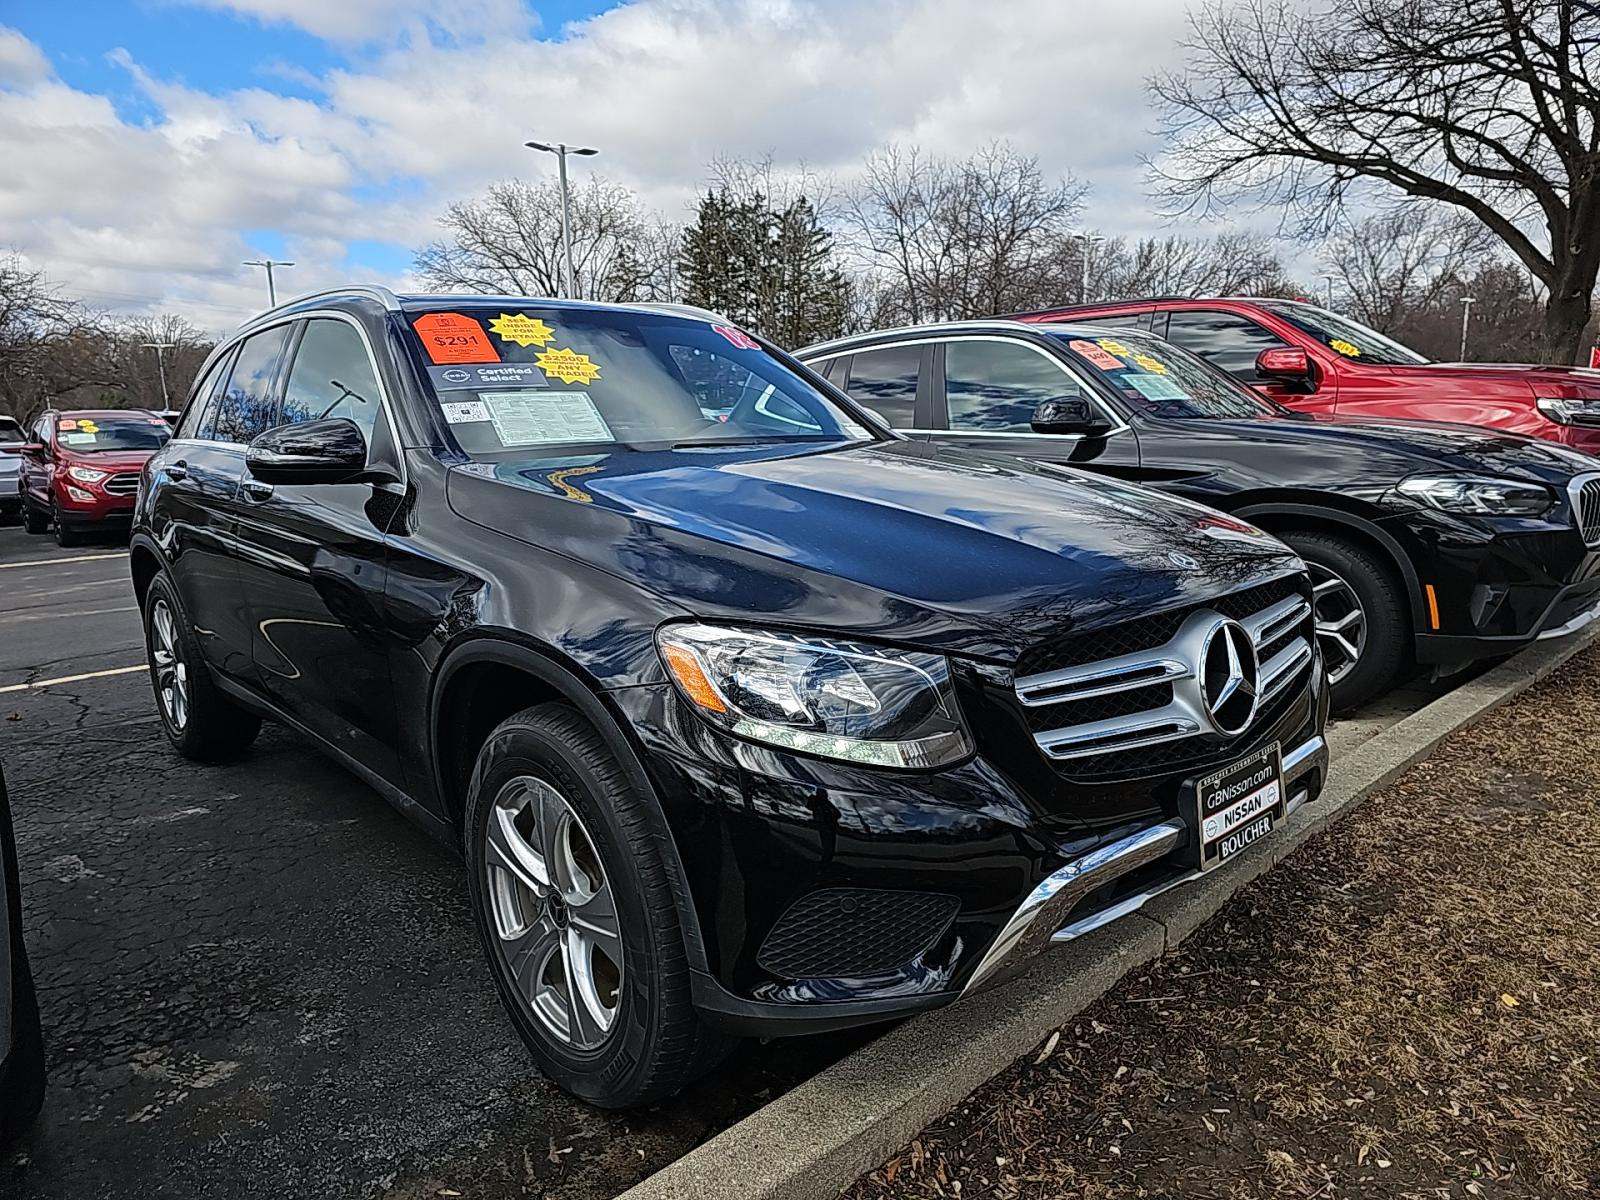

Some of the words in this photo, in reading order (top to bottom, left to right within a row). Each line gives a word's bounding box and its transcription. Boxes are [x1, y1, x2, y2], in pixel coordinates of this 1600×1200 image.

[433, 335, 479, 347] $291
[543, 354, 584, 362] $2500
[476, 367, 533, 376] Certified
[480, 374, 523, 382] Select
[1207, 766, 1272, 809] GBNissan.com
[1224, 794, 1262, 828] NISSAN
[1221, 816, 1271, 858] BOUCHER
